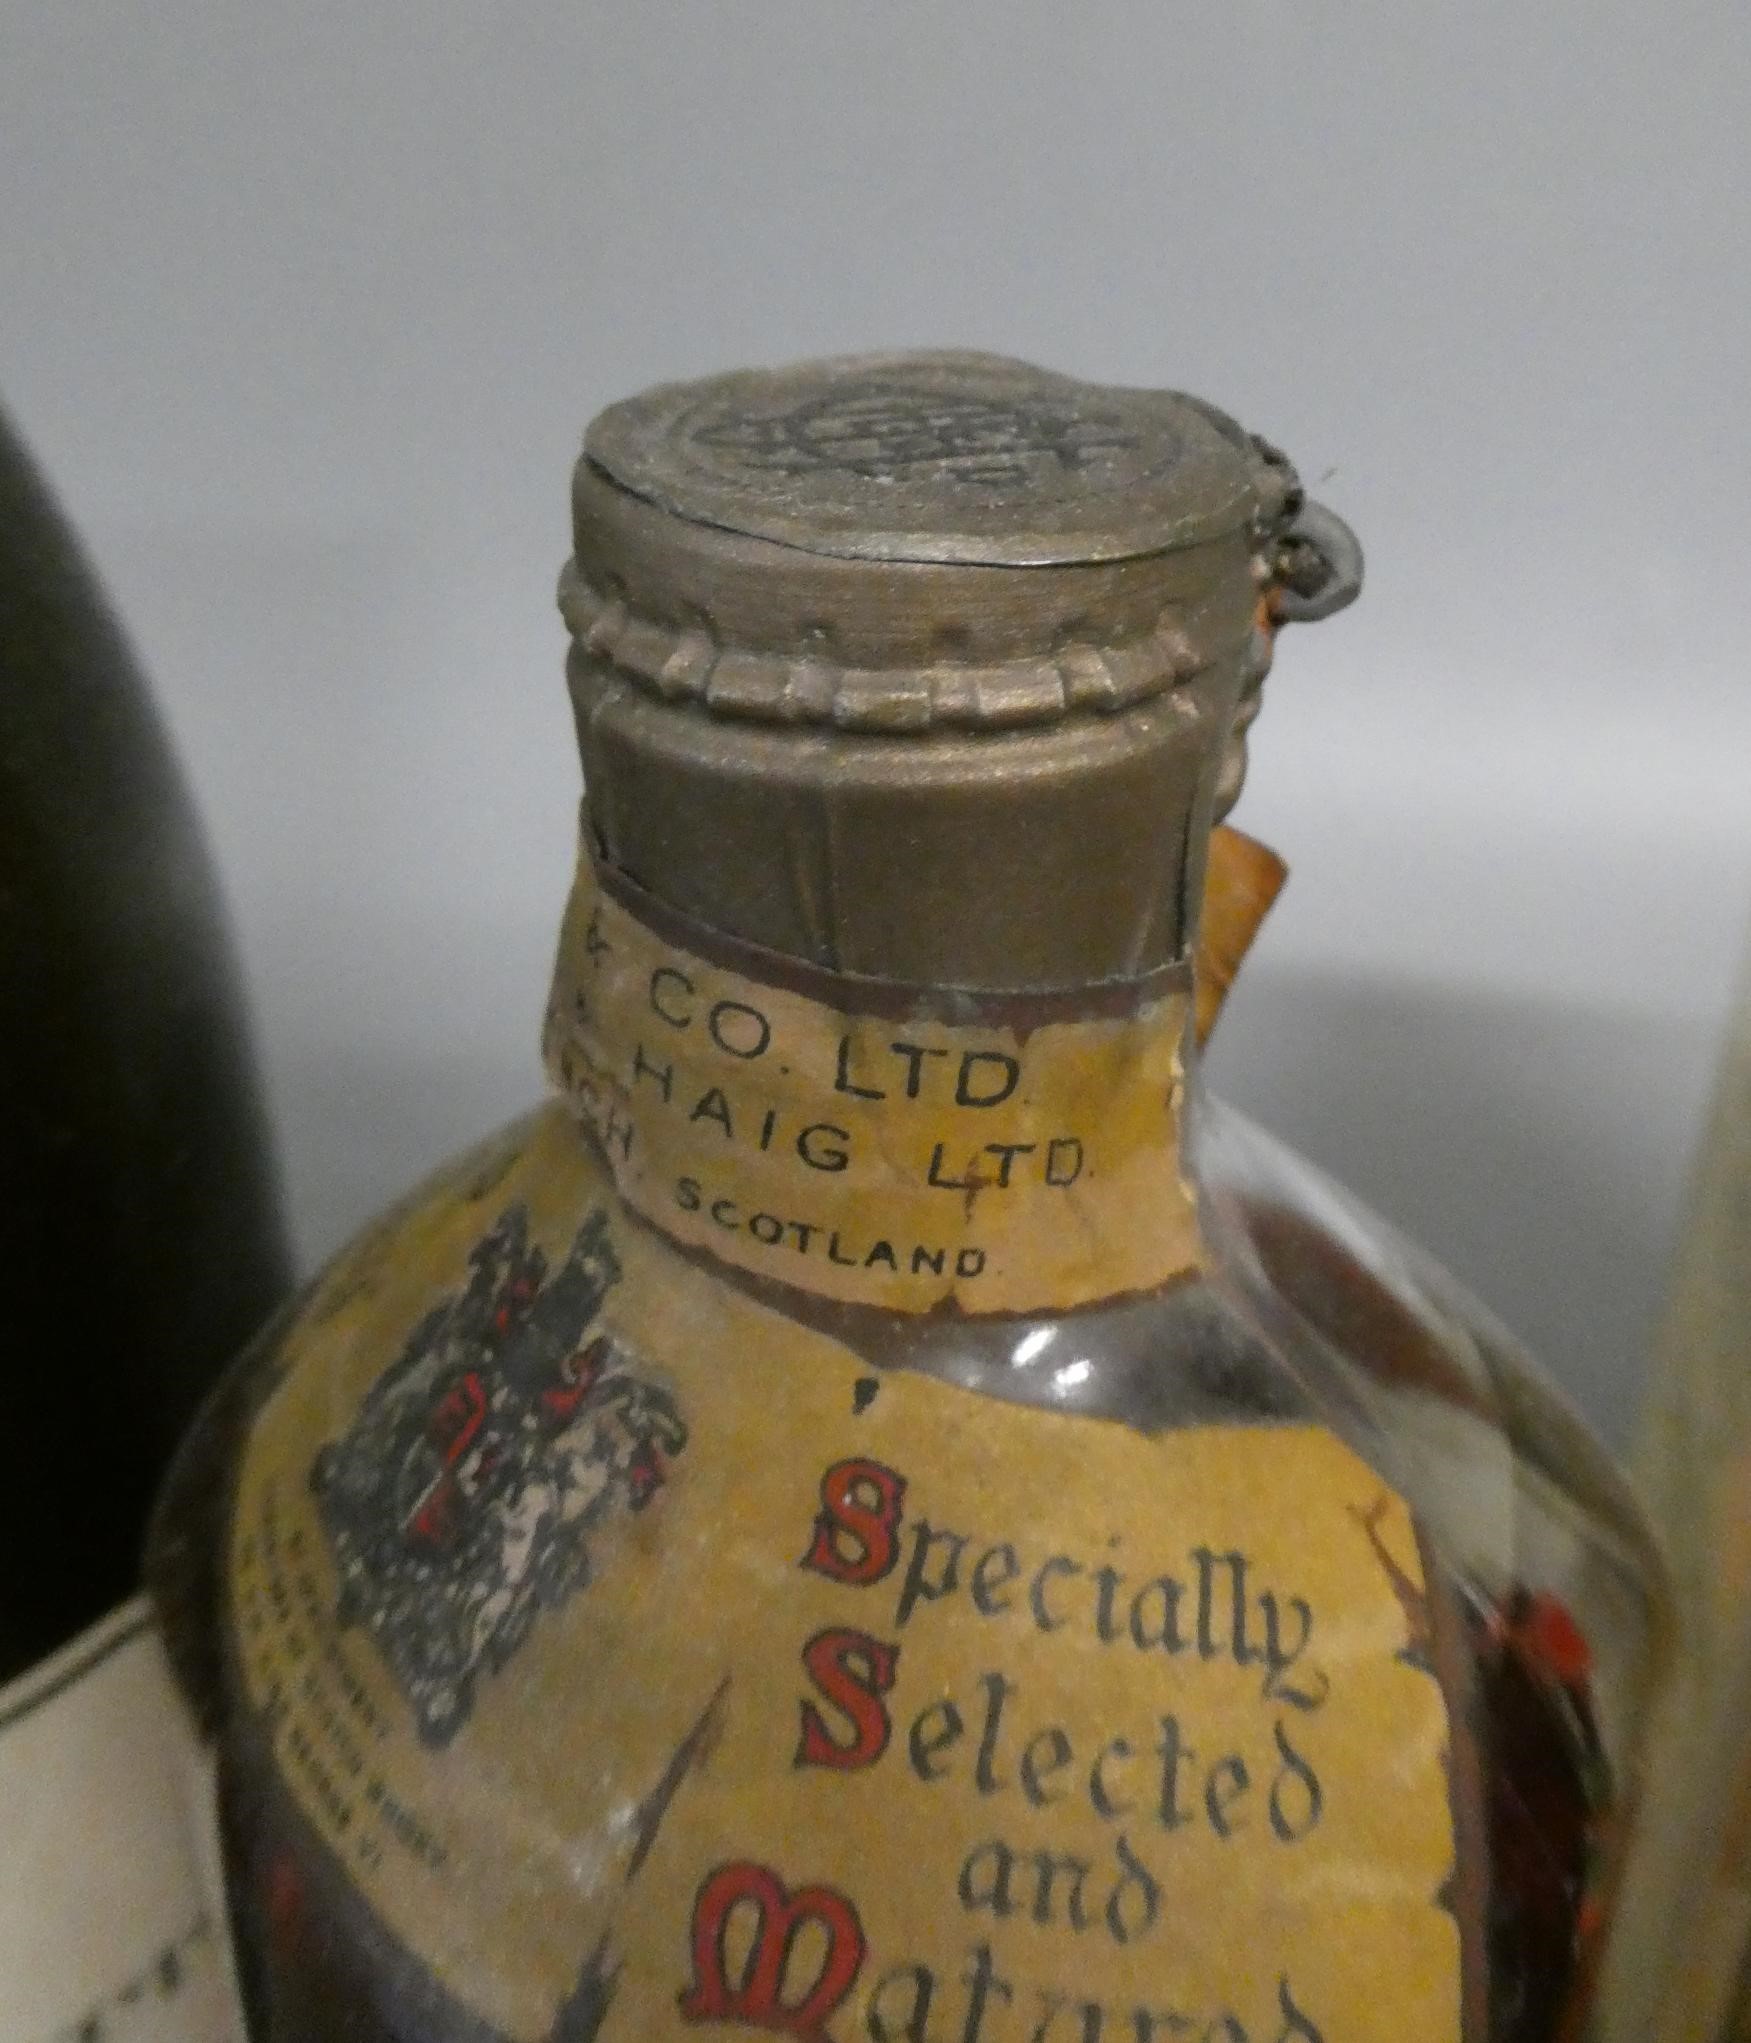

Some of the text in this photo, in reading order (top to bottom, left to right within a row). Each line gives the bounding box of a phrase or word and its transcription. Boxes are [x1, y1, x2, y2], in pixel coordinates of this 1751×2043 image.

[649, 967, 789, 1076] CO.
[632, 1042, 851, 1172] HAIG
[799, 1456, 1330, 1713] Specially
[793, 1625, 1324, 1844] Selected
[957, 1835, 1163, 1945] and
